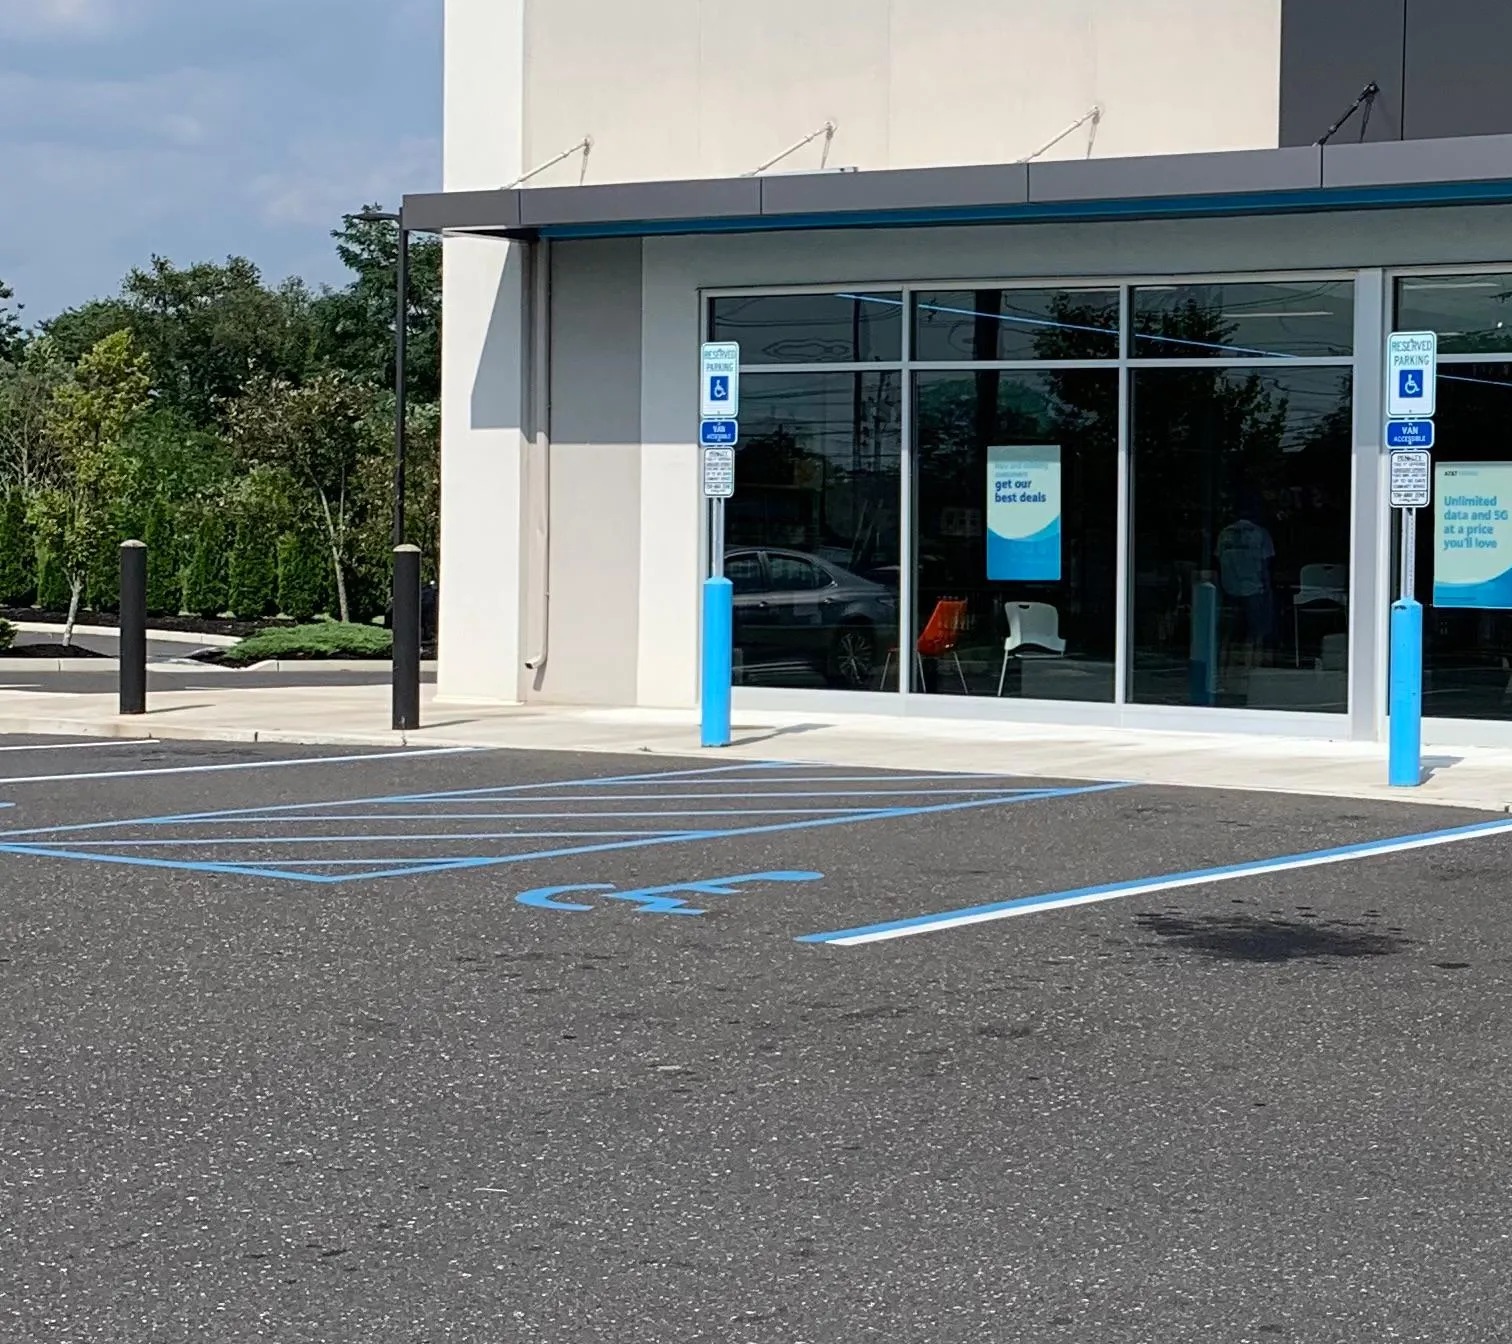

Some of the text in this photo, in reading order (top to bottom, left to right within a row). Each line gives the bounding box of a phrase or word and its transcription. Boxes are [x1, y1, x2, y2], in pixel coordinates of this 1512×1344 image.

[1392, 340, 1432, 351] RESERVED
[1394, 355, 1429, 366] PARKING
[1402, 426, 1419, 434] VAN
[995, 480, 1032, 492] get our
[995, 491, 1047, 503] best deals
[1444, 496, 1497, 506] Unlimited
[1444, 510, 1508, 520] data and 5G
[1444, 524, 1494, 536] at a price
[1444, 537, 1497, 551] you'll love
